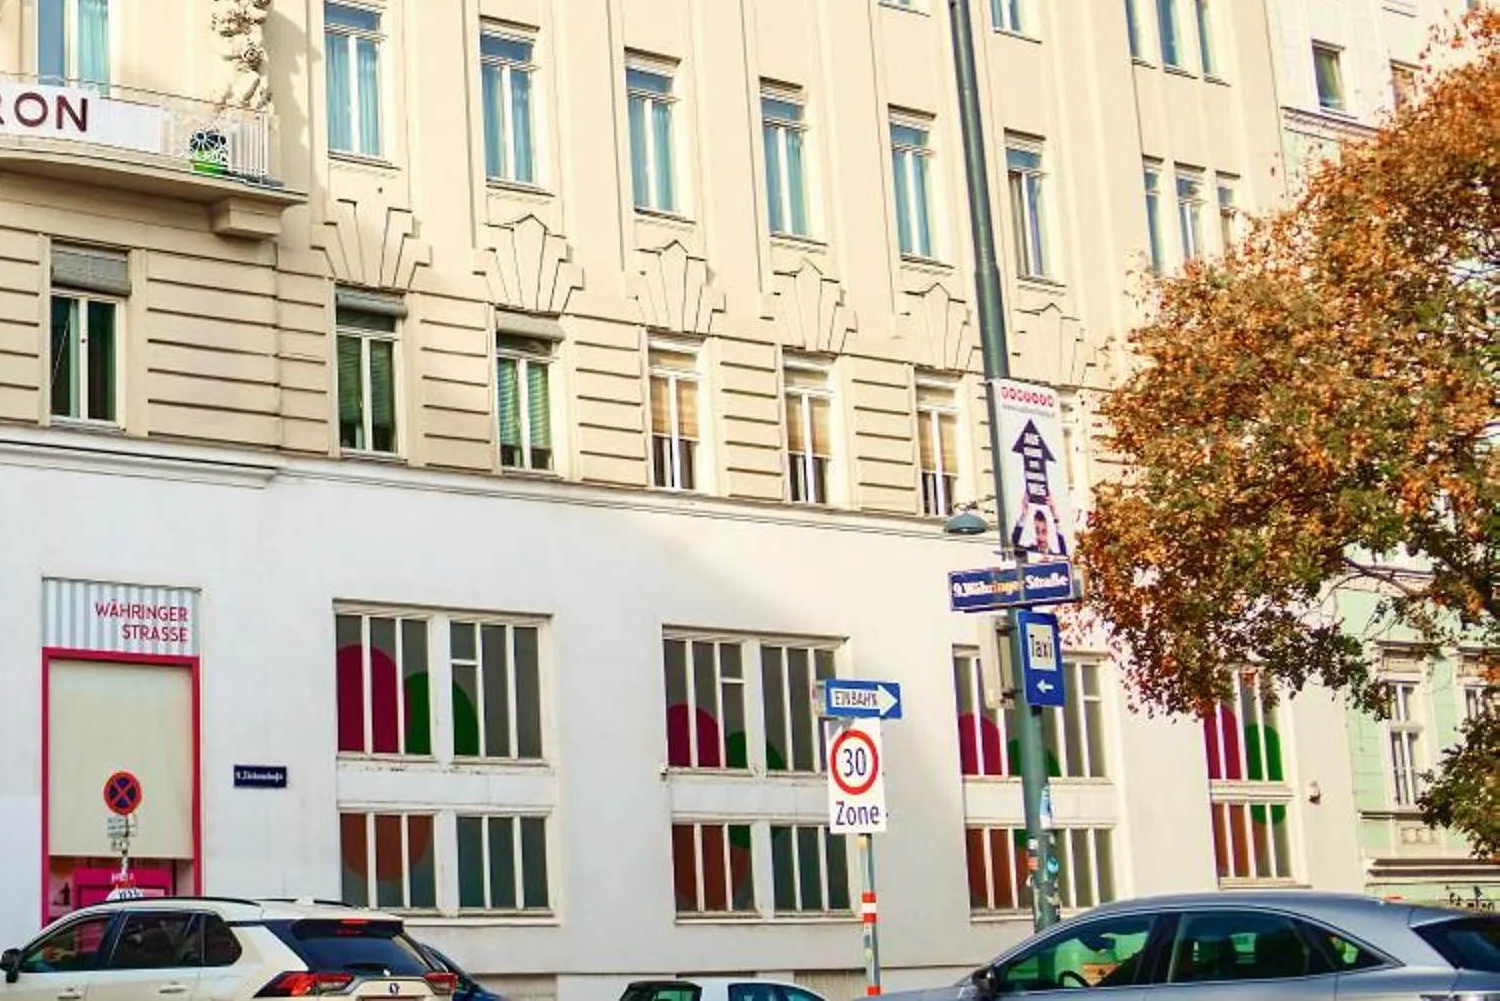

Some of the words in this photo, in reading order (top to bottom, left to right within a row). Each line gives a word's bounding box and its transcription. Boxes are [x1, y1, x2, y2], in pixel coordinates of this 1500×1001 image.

[95, 599, 188, 622] WÄHRINGER
[122, 624, 188, 642] STRASSE
[1029, 633, 1053, 659] Taxi
[843, 747, 867, 777] 30
[835, 800, 880, 826] Zone
